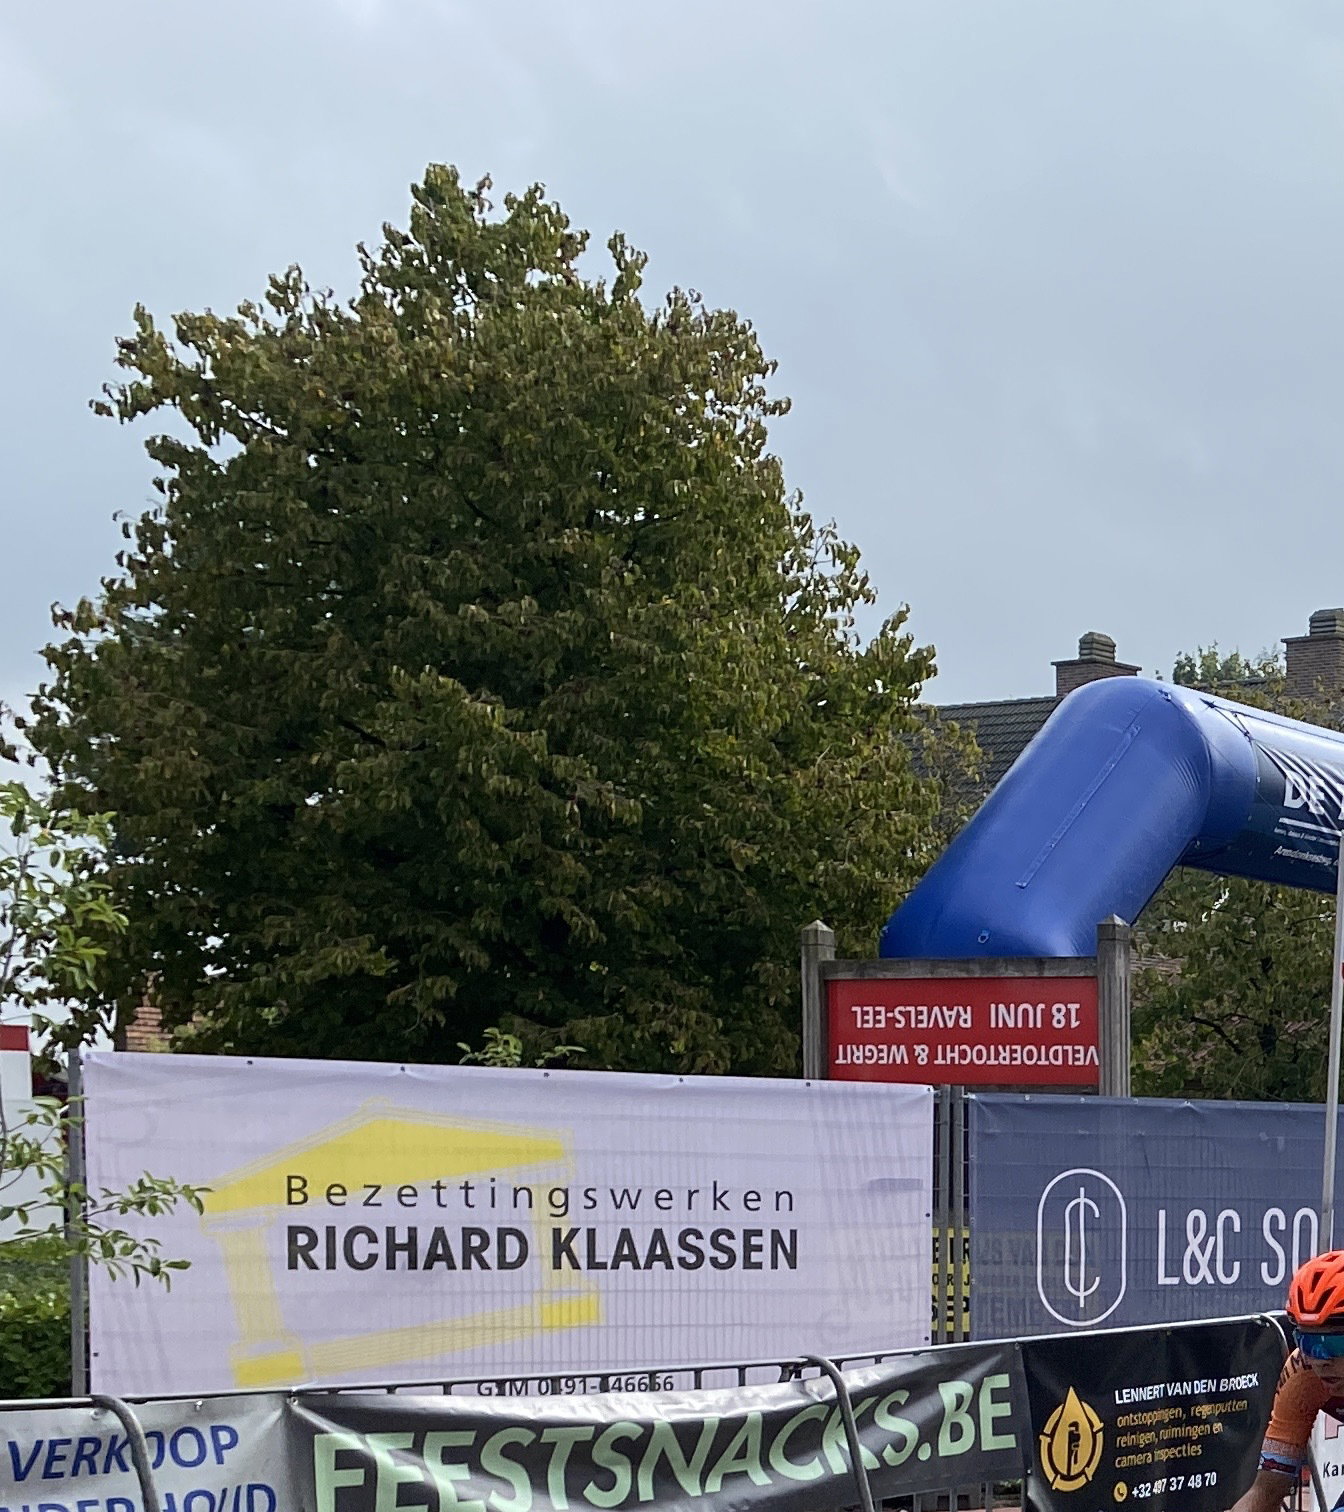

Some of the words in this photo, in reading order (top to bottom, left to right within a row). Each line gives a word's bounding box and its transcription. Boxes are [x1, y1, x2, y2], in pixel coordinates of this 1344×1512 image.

[1284, 769, 1325, 815] DE
[851, 1004, 972, 1029] RAVELS-EEL
[990, 1003, 1046, 1028] JUNI
[1052, 1003, 1081, 1028] 18
[835, 1044, 909, 1065] WEGRIT
[913, 1044, 930, 1065] &
[934, 1044, 1100, 1066] VELDTOERTOCHT
[286, 1175, 796, 1218] Bezettingswerken
[286, 1225, 530, 1272] RICHARD
[551, 1226, 799, 1272] KLAASSEN
[1157, 1207, 1242, 1287] L&C
[1115, 1384, 1165, 1405] LENNERT
[1166, 1382, 1192, 1397] VAN
[1193, 1379, 1216, 1394] DEN
[1219, 1372, 1259, 1392] BROECK
[1116, 1432, 1158, 1448] reinigen,
[1212, 1422, 1223, 1434] en
[1115, 1452, 1152, 1468] camera
[1132, 1482, 1151, 1498] +32
[1169, 1476, 1185, 1491] 37
[1187, 1474, 1202, 1488] 48
[1204, 1471, 1217, 1486] 70
